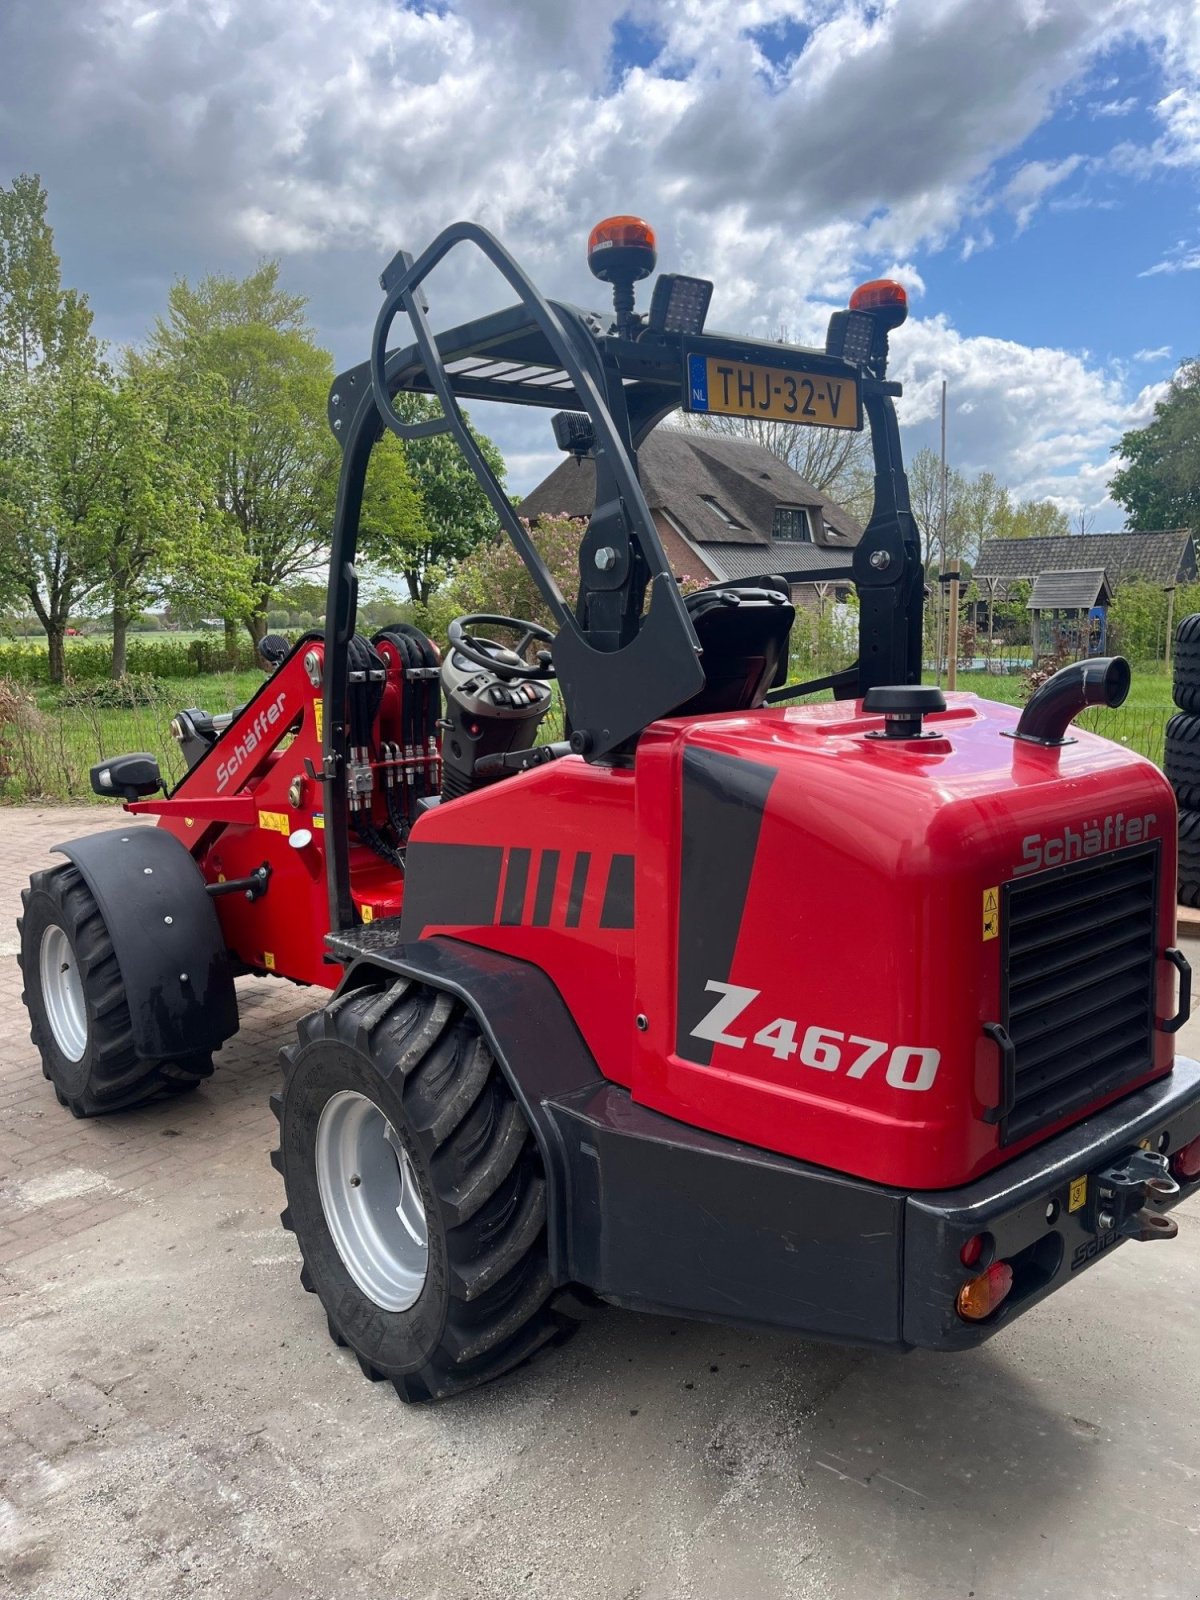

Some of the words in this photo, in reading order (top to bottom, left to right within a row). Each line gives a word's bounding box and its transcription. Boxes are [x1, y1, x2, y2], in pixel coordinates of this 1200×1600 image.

[692, 389, 706, 402] NL
[716, 366, 842, 419] THJ-32-V
[216, 692, 286, 793] Schäffer
[1012, 813, 1157, 875] Schäffer
